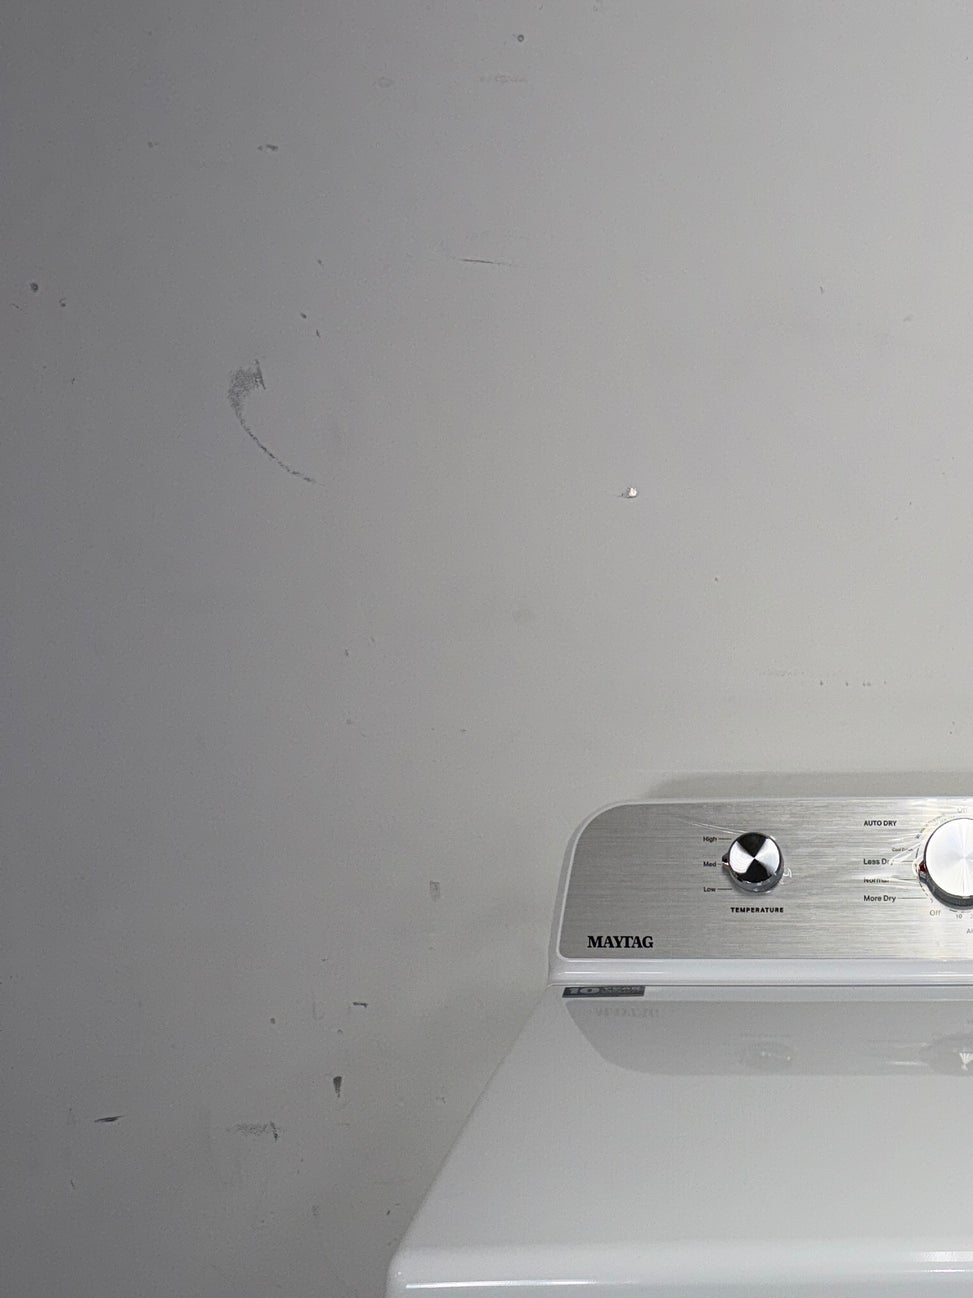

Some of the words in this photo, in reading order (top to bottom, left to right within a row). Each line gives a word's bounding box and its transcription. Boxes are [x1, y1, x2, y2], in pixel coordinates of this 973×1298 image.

[702, 836, 718, 844] High
[703, 860, 717, 868] Med
[863, 857, 880, 866] Less
[863, 894, 882, 902] More
[883, 894, 897, 903] Dry
[730, 906, 785, 914] TEMPERATURE
[587, 935, 654, 949] MAYTAG
[568, 986, 600, 995] 10
